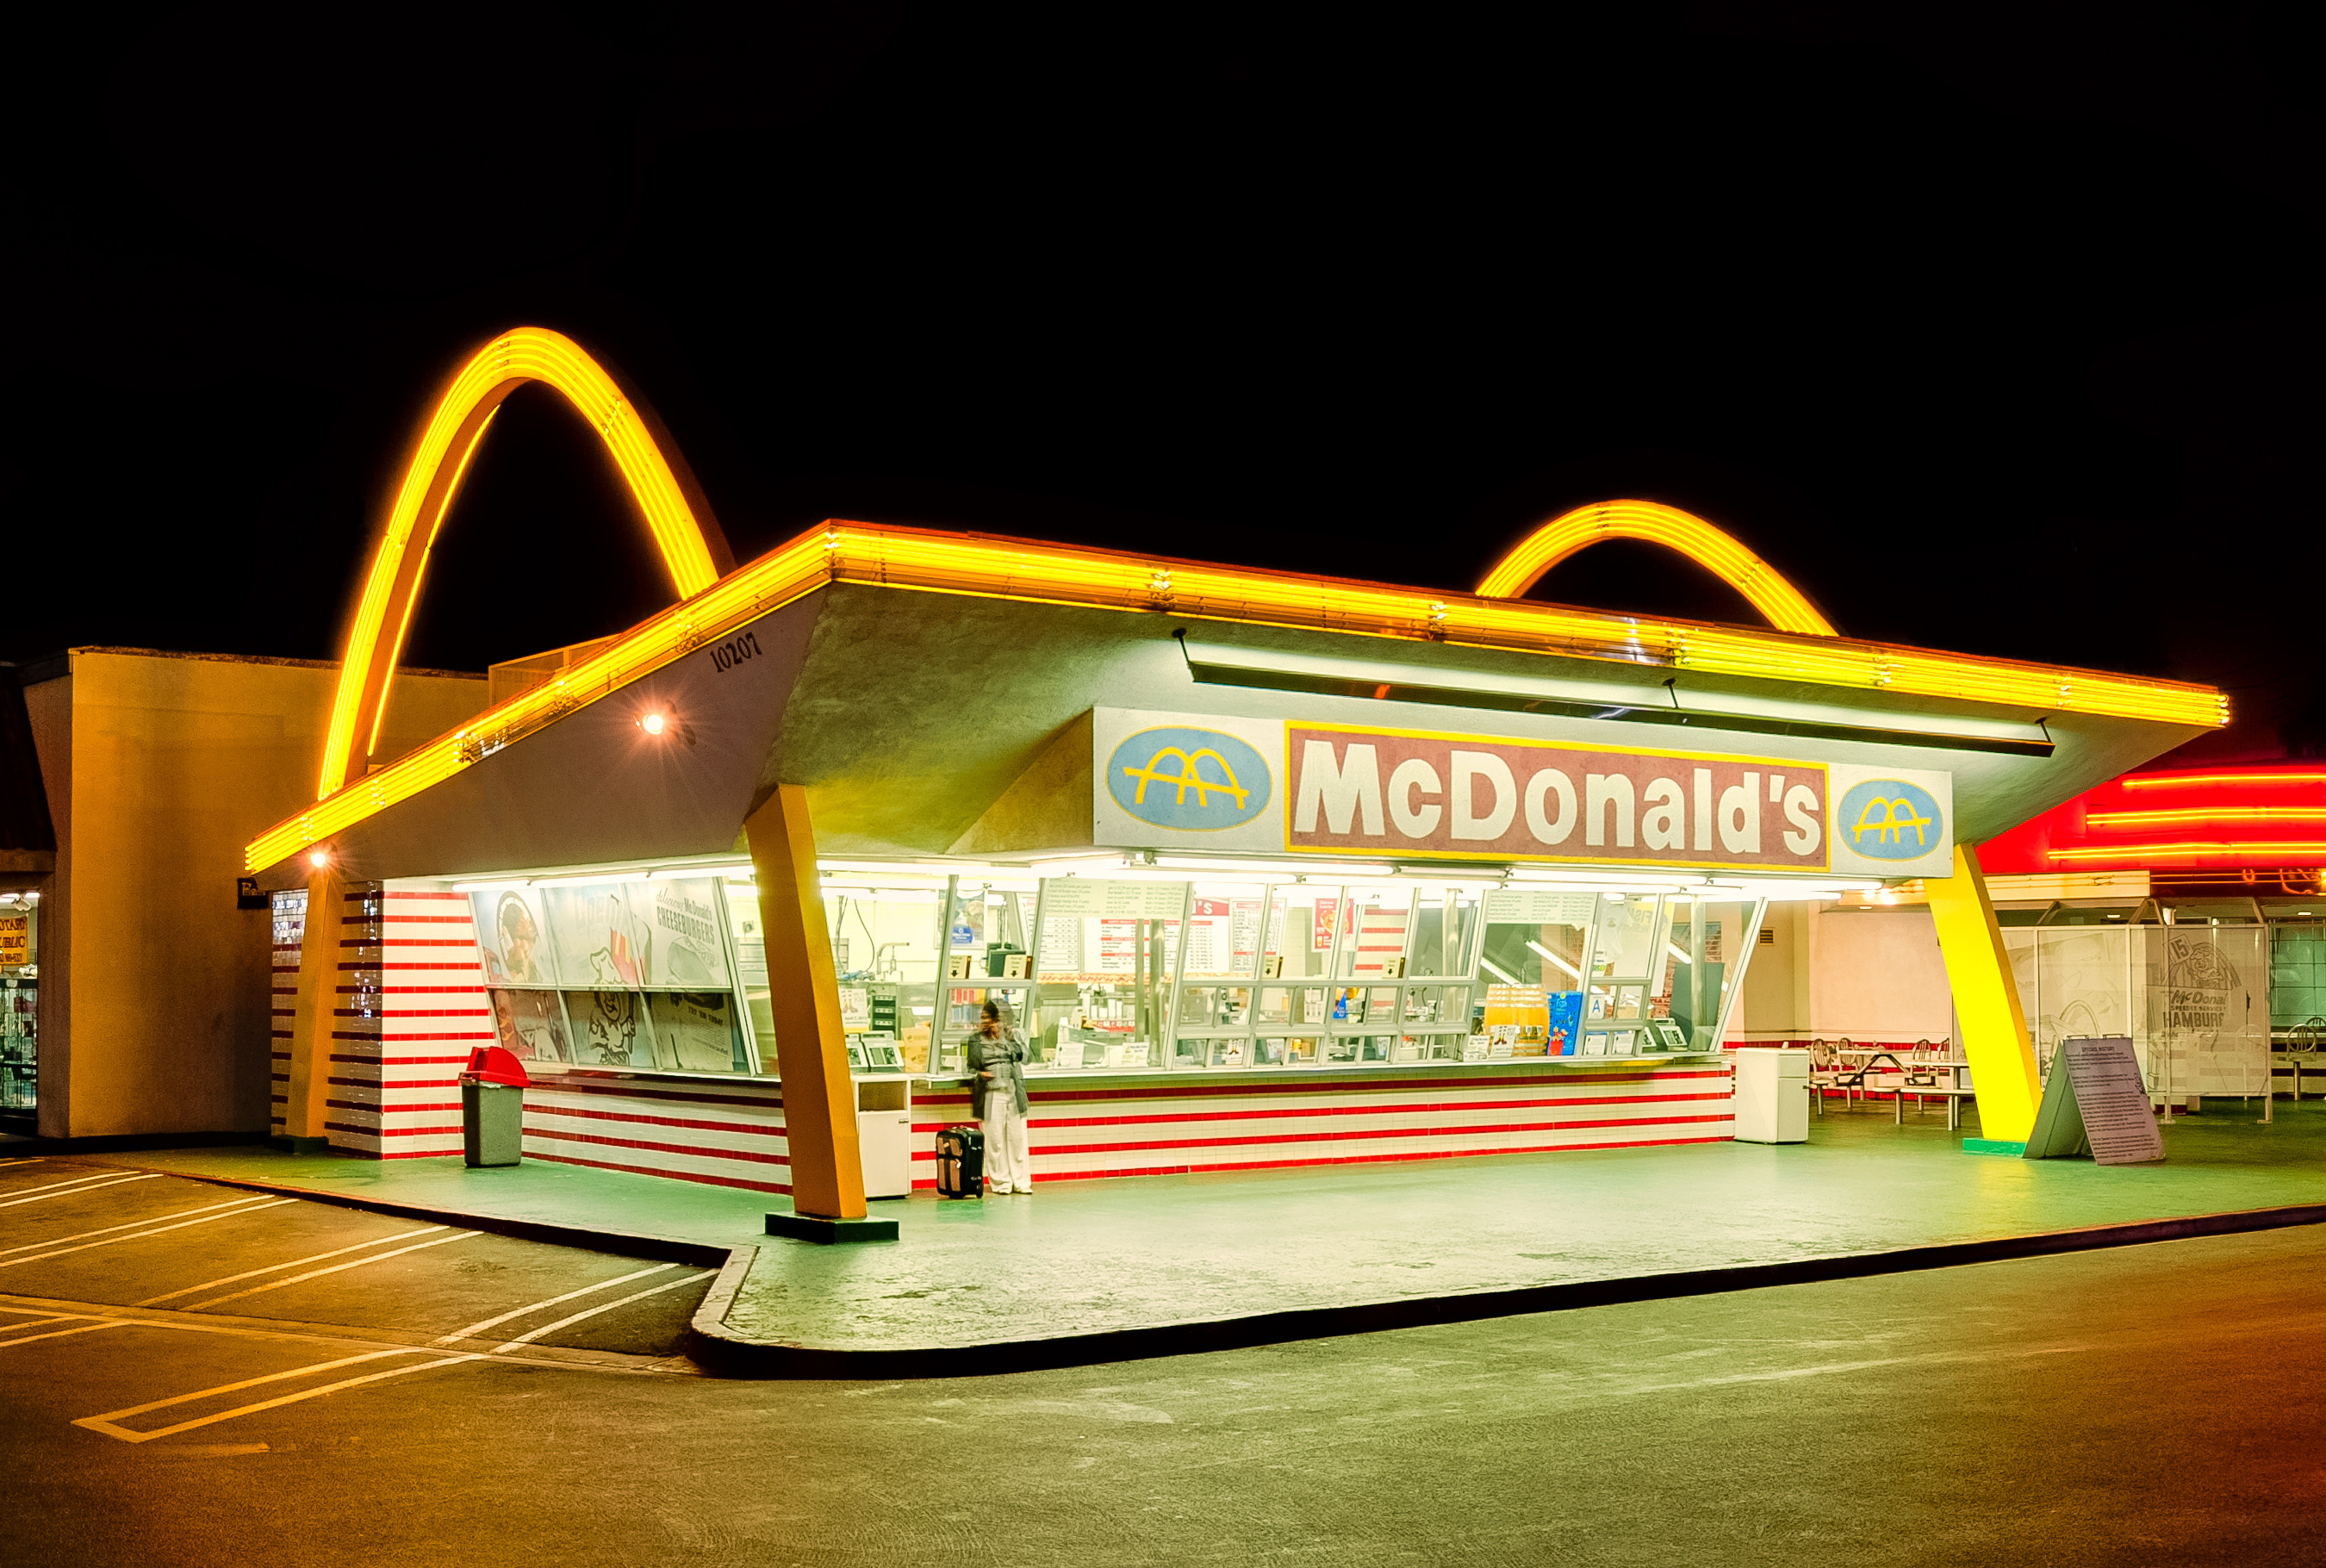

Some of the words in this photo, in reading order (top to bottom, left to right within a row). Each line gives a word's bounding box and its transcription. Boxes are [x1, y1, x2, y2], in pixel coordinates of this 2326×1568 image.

[709, 632, 762, 673] 10207
[1294, 738, 1821, 856] McDonald's
[656, 906, 715, 945] CHEESEBURGERS
[2170, 938, 2189, 959] 15
[1591, 999, 1601, 1013] A
